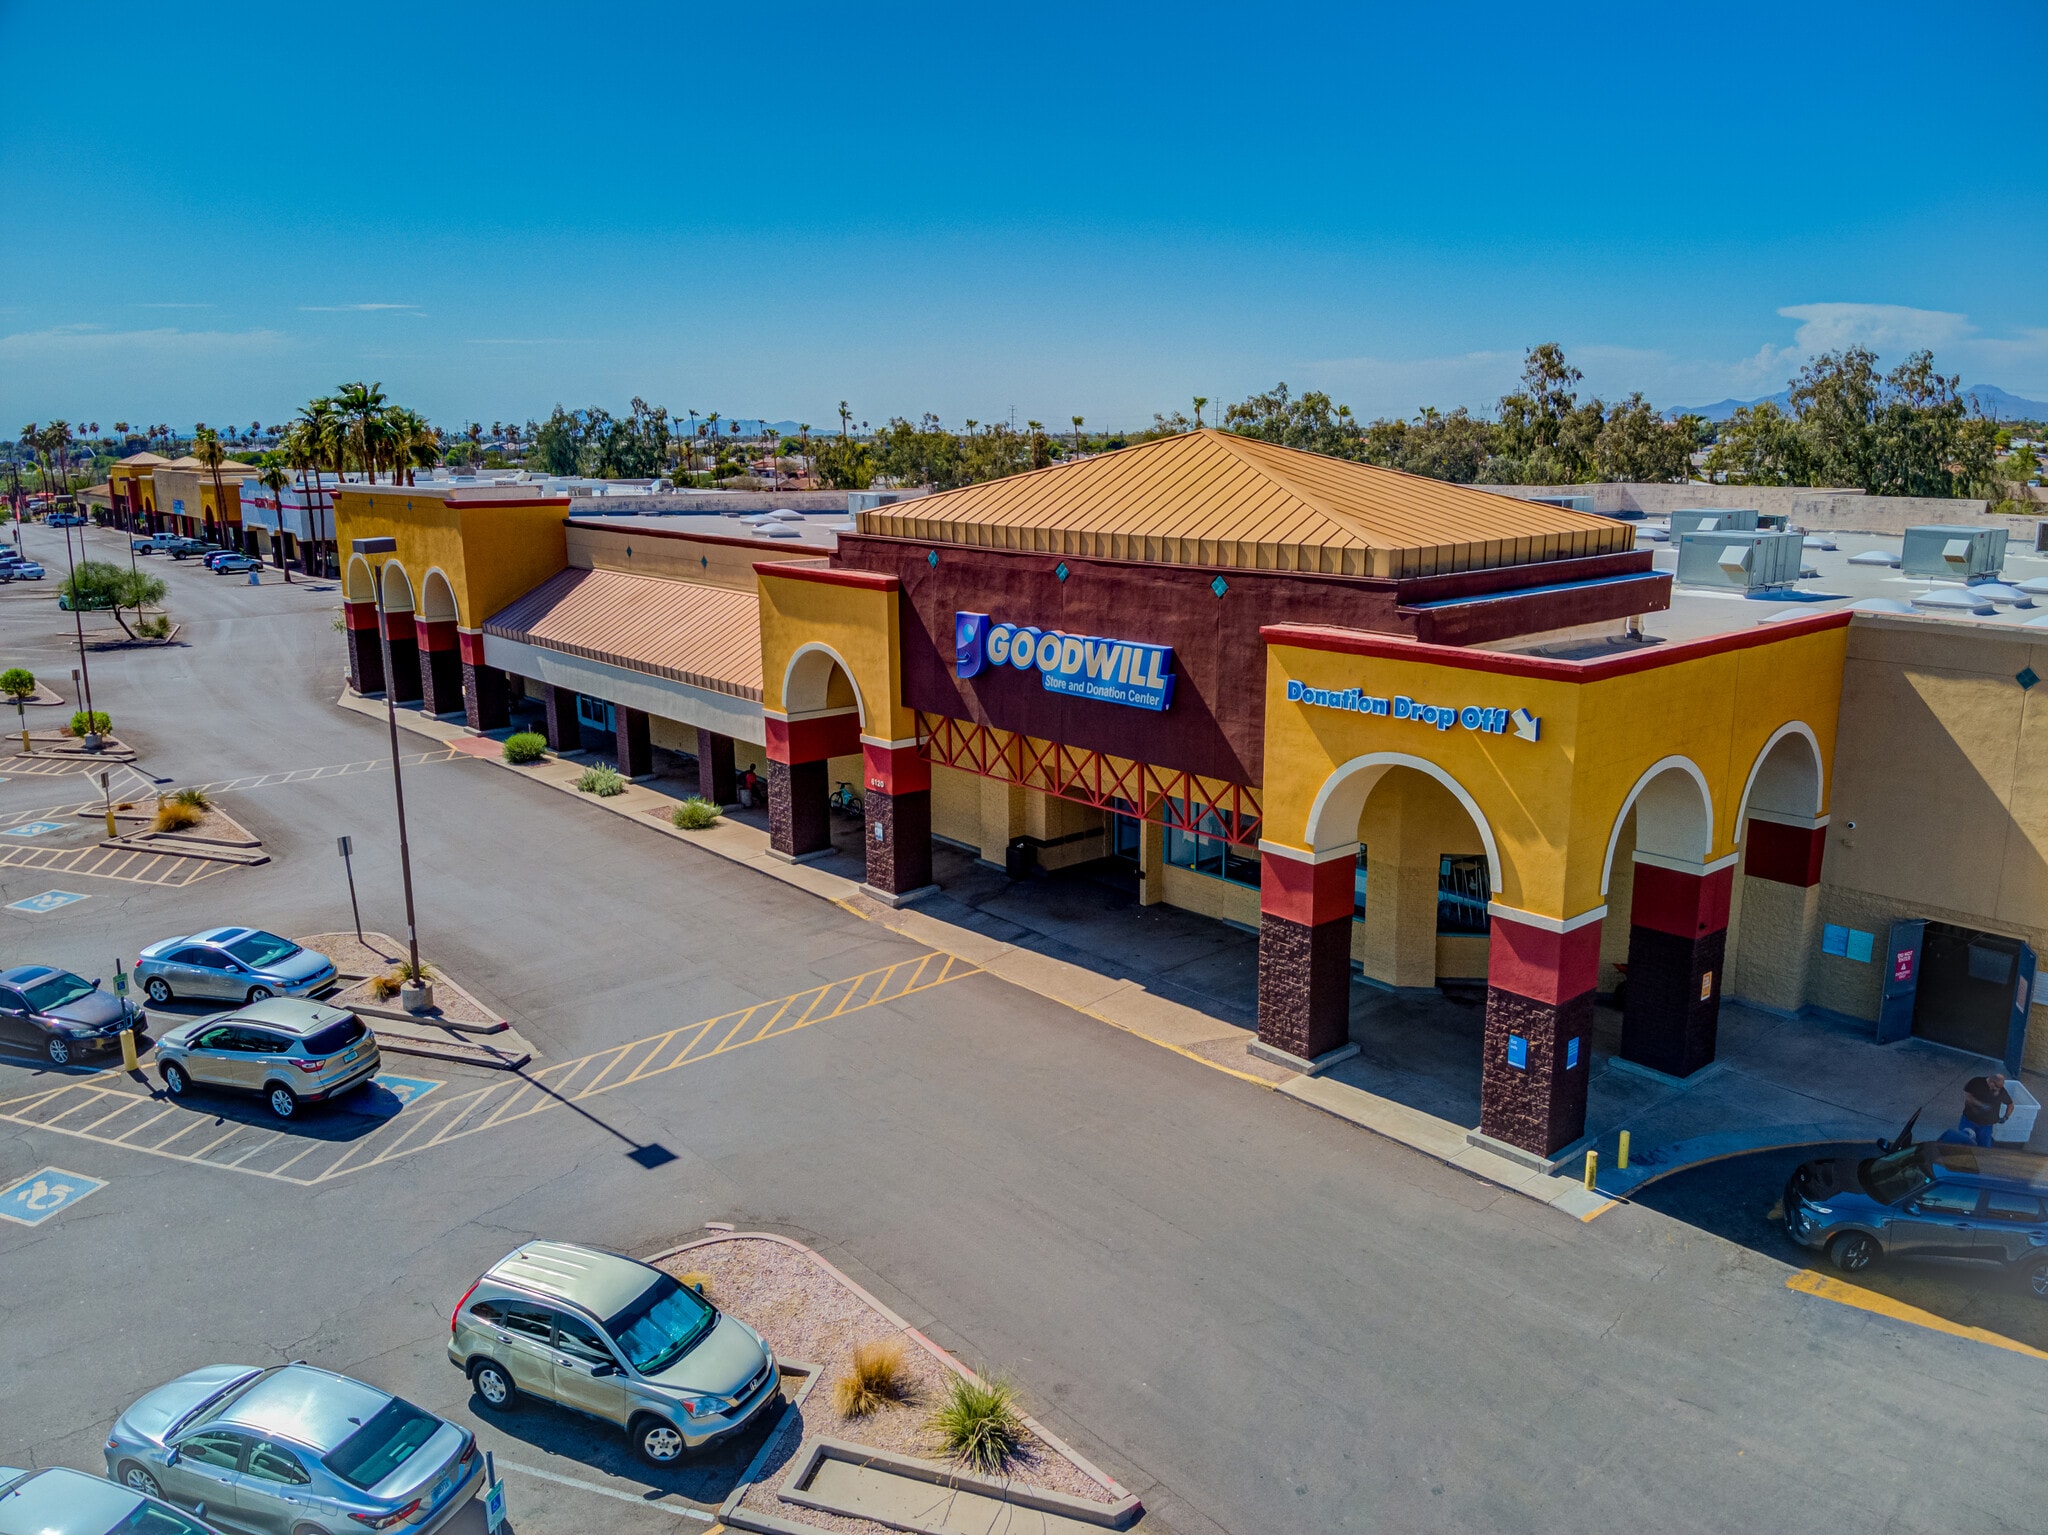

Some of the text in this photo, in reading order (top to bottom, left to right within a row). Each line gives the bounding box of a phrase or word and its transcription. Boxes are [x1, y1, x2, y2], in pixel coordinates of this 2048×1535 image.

[986, 626, 1165, 689] GOODWILL
[1045, 674, 1160, 706] Store and Donation Center
[1286, 679, 1510, 735] Donation Drop Off
